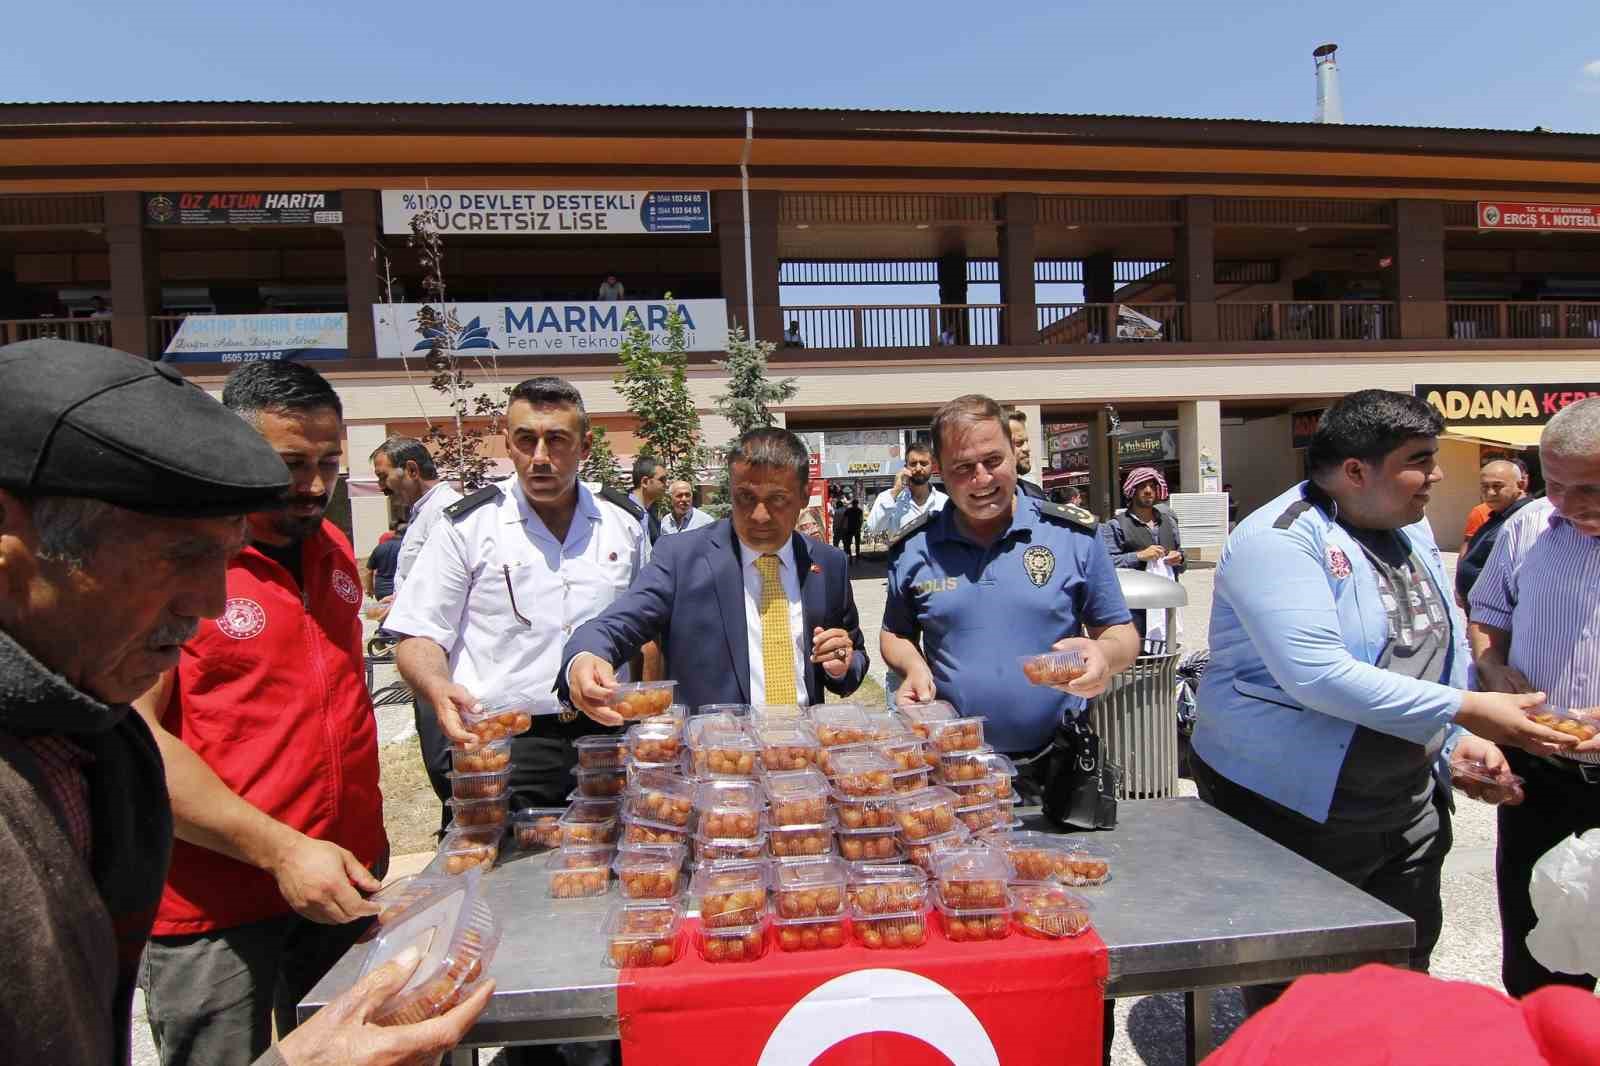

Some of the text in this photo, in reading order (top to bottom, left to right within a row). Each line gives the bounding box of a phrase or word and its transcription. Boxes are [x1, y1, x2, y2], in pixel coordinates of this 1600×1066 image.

[208, 193, 263, 209] ALTUN
[402, 194, 635, 210] %100 DEVLET DESTEKLİ
[559, 211, 608, 231] LİSE
[1503, 213, 1538, 228] ERCİŞ
[1541, 213, 1551, 226] 1.
[507, 336, 539, 349] Fen
[544, 338, 563, 349] ve
[1426, 390, 1540, 419] ADANA
